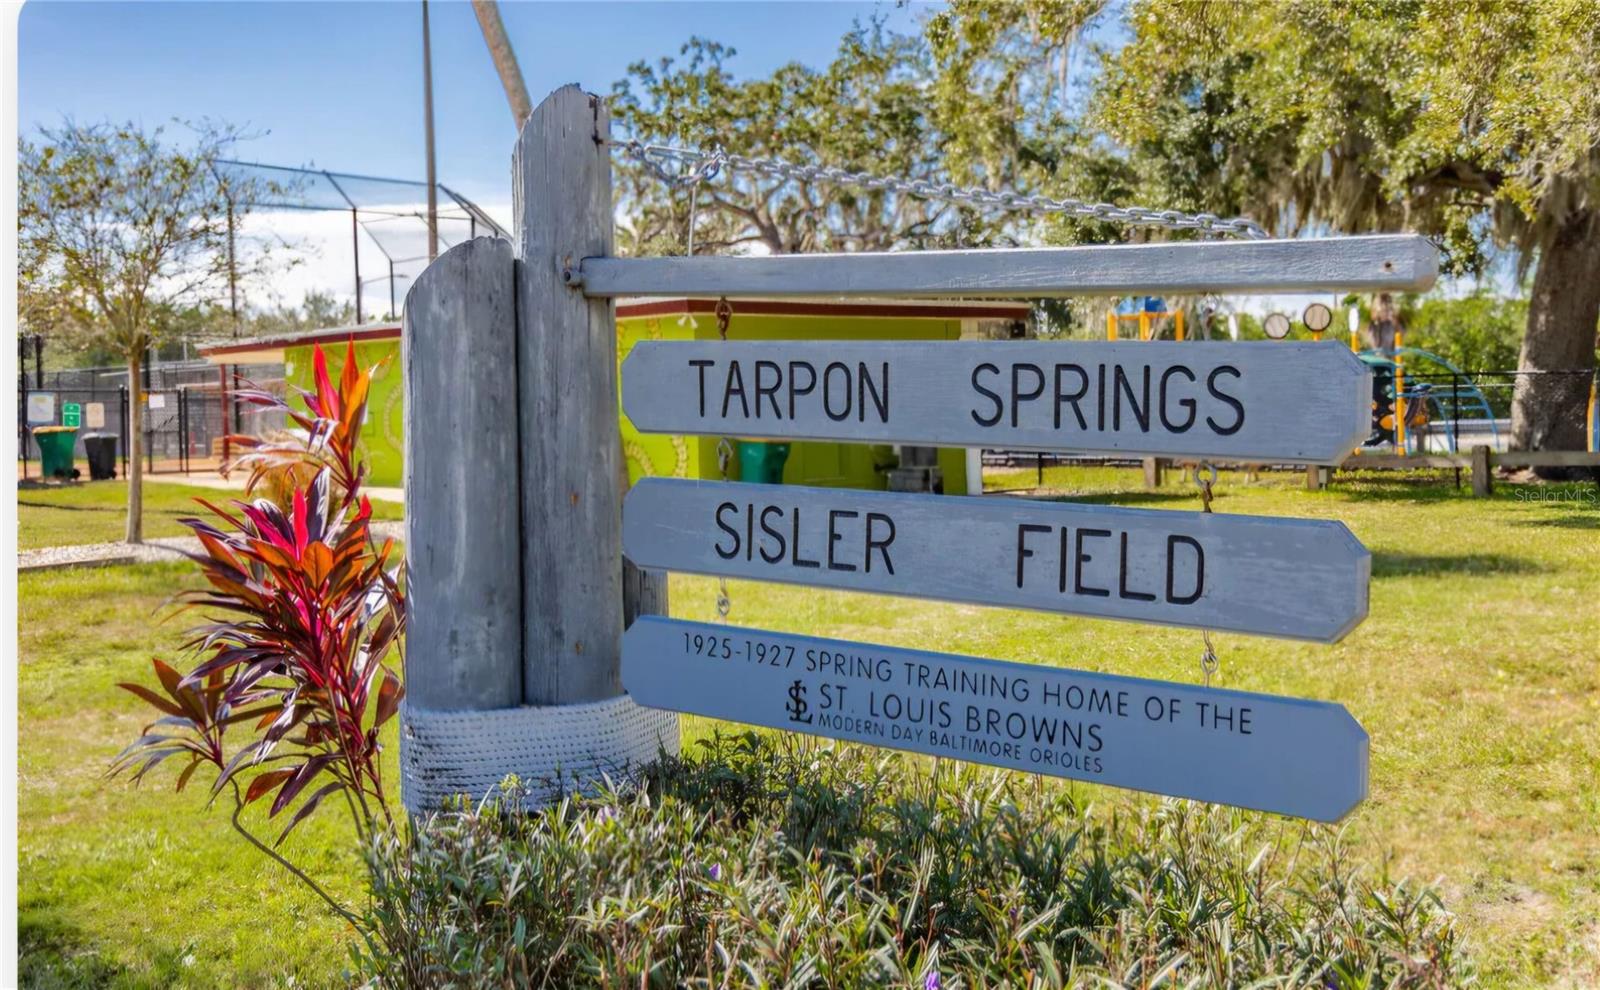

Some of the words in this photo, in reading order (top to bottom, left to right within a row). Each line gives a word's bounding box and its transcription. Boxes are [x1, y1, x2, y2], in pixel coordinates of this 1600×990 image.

[689, 360, 888, 423] TARPON
[971, 363, 1245, 436] SPRINGS
[714, 502, 896, 575] SISLER
[1016, 523, 1205, 605] FIELD
[684, 632, 795, 669] 1925-1927
[806, 649, 892, 682] SPRING
[904, 662, 1030, 703] TRAINING
[1044, 682, 1129, 718] HOME
[1144, 696, 1181, 723] OF
[1196, 702, 1253, 735] THE
[819, 683, 855, 714] ST.
[869, 691, 952, 729] LOUIS
[966, 705, 1104, 753] BROWNS
[818, 714, 885, 738] MODERN
[891, 725, 924, 743] DAY
[930, 729, 1022, 760] BALTIMORE
[1030, 747, 1104, 774] ORIOLES
